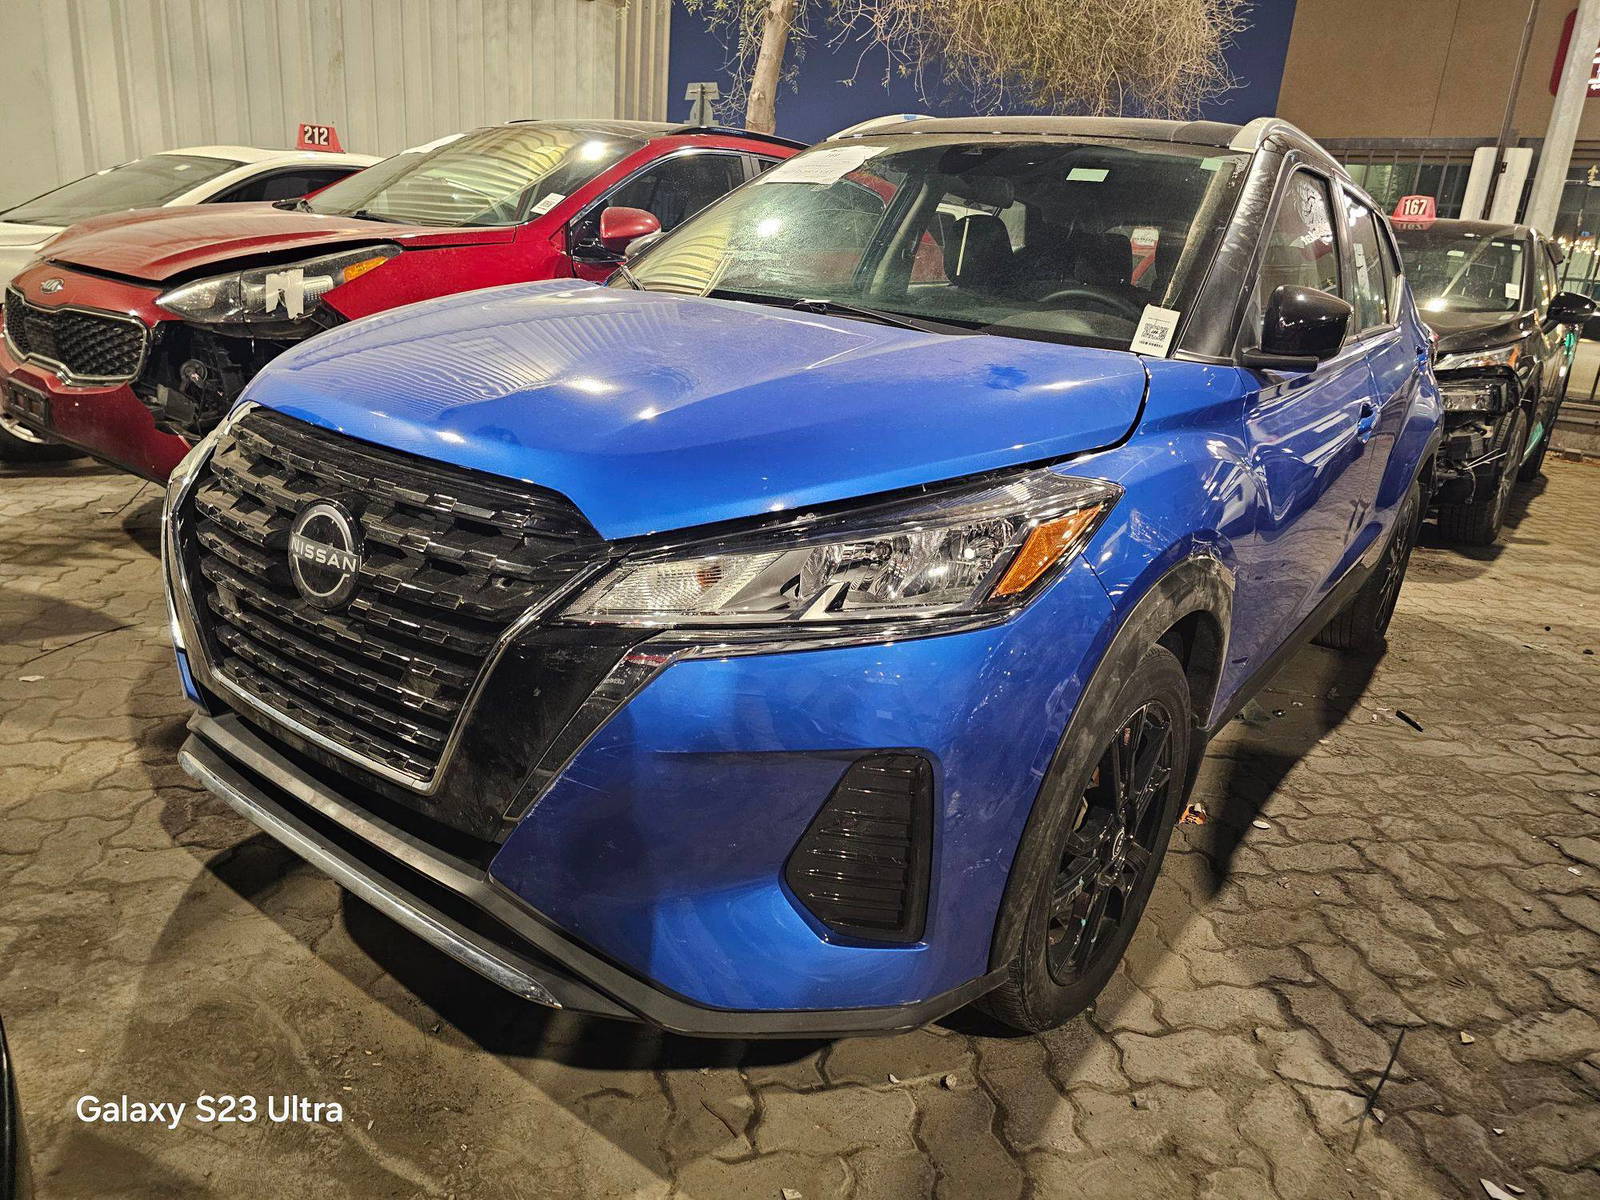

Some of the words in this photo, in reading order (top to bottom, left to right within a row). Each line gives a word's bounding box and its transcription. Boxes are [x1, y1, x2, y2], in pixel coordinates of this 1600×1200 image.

[303, 125, 329, 146] 212
[1404, 199, 1428, 216] 167
[290, 534, 358, 573] NISSAN
